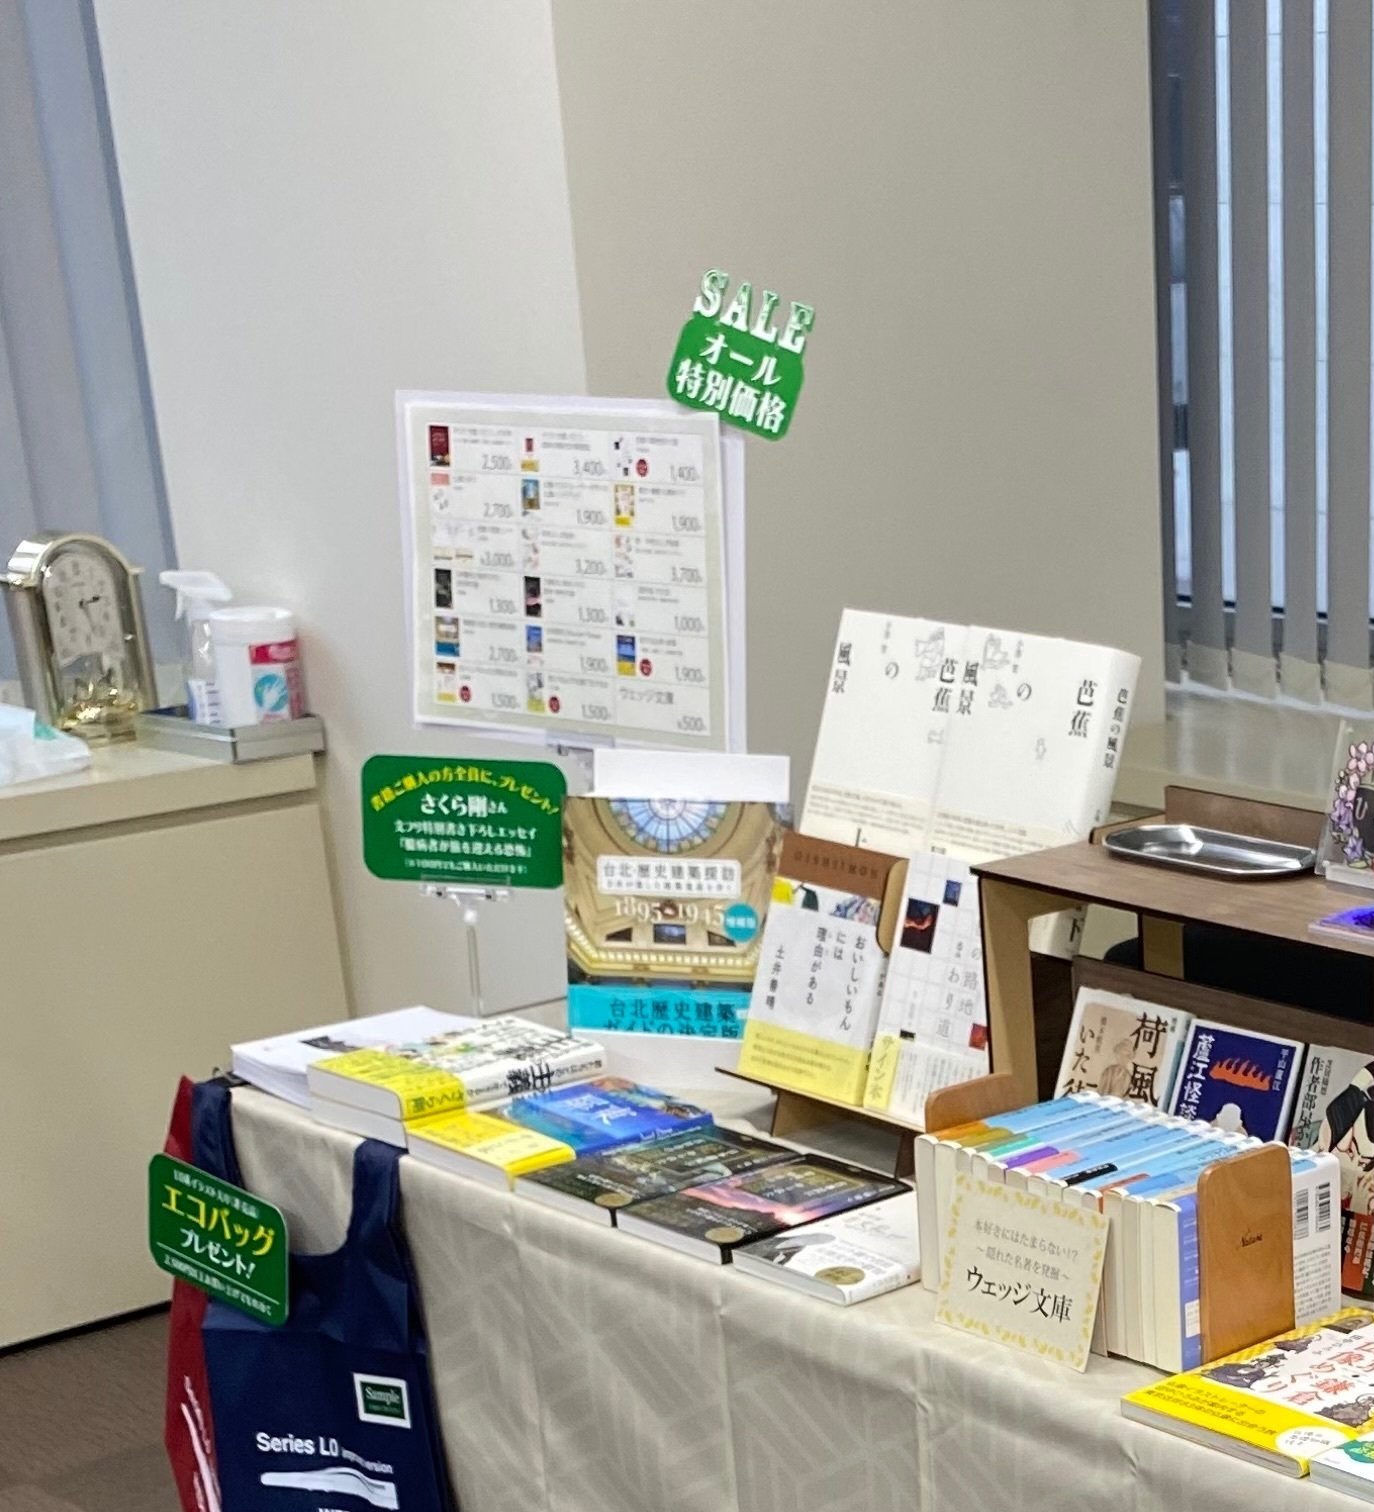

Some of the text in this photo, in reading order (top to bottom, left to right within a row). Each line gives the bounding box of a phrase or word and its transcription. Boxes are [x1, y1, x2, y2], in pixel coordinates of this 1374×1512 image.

[693, 269, 815, 354] SALE
[699, 333, 782, 386] オール
[675, 358, 787, 434] 特別価格
[831, 641, 853, 694] 風景
[884, 661, 900, 680] の
[932, 657, 960, 714] 芭蕉
[955, 660, 979, 716] 風景
[1016, 682, 1033, 701] の
[1068, 678, 1098, 739] 芭蕉
[1103, 687, 1129, 769] 芭蕉の風景
[420, 792, 509, 818] さくら剛さん
[833, 931, 846, 961] には
[1122, 1011, 1169, 1108] 荷風
[161, 1184, 275, 1256] エコバッグ
[180, 1228, 256, 1279] プレゼント!
[966, 1265, 1074, 1325] ウェッジ文庫
[365, 1385, 400, 1405] Sample
[256, 1431, 315, 1455] Series
